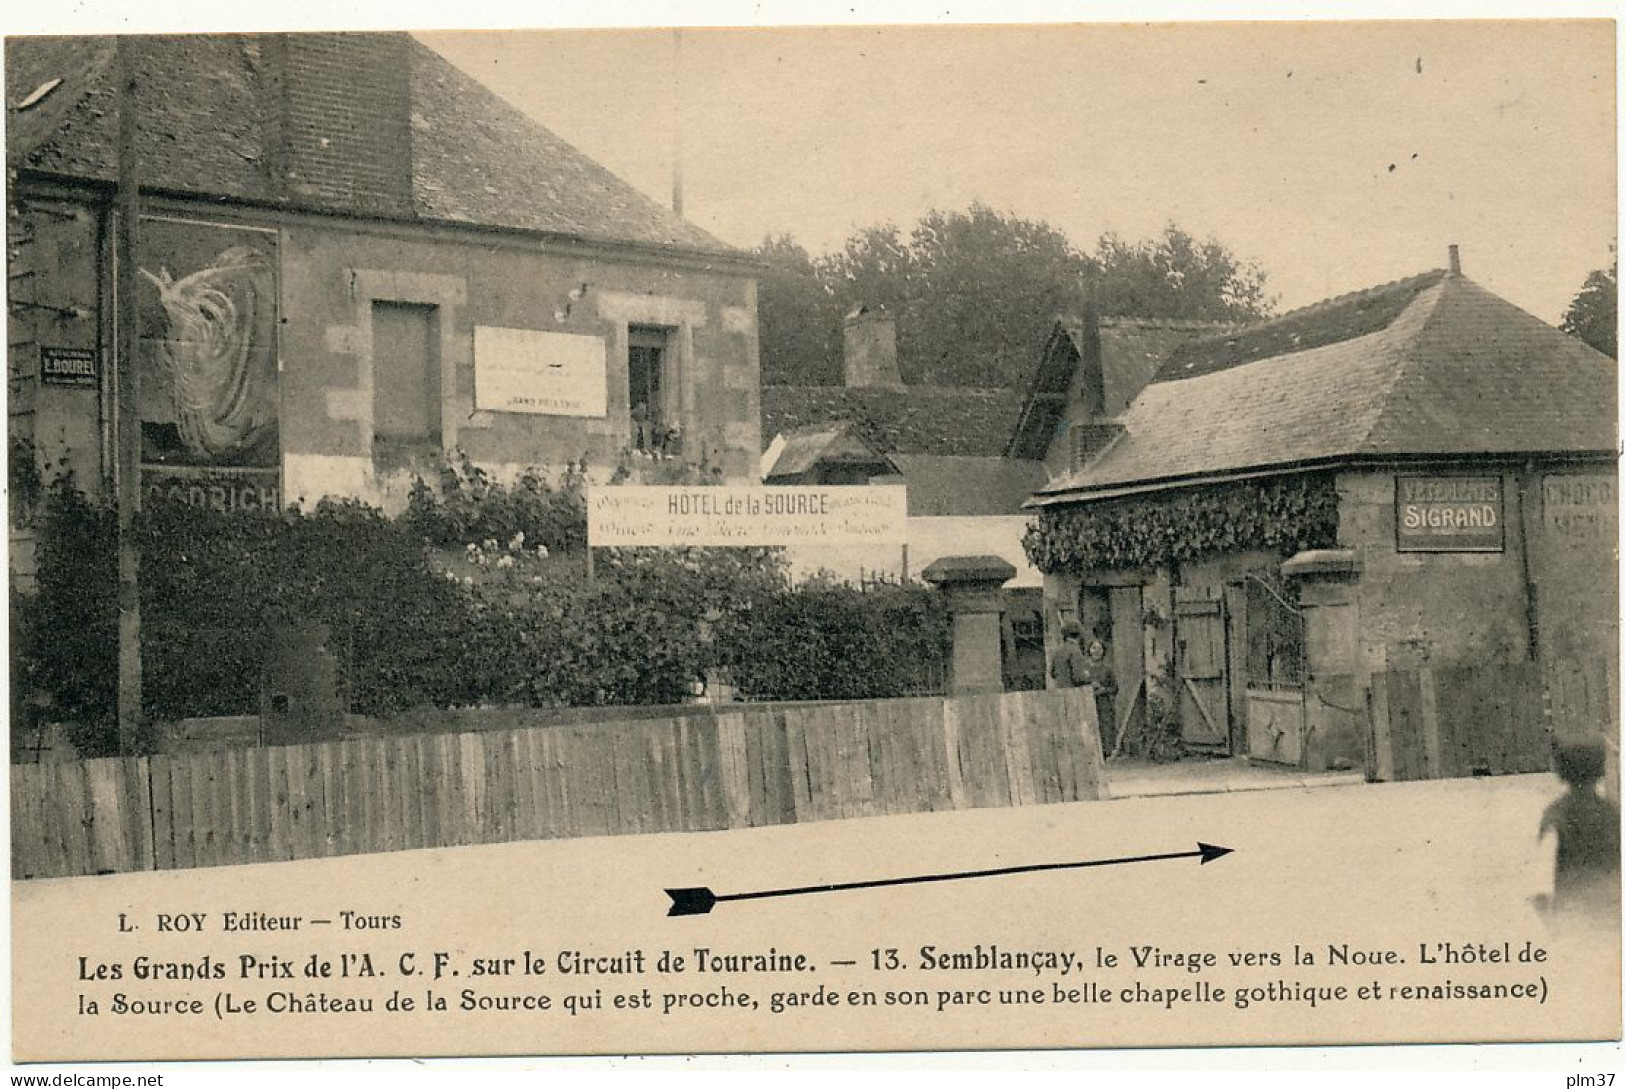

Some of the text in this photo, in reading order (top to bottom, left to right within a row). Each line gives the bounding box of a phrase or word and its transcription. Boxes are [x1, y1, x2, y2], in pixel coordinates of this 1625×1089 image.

[725, 494, 742, 515] de
[747, 494, 760, 515] la
[765, 493, 829, 516] SOURCE
